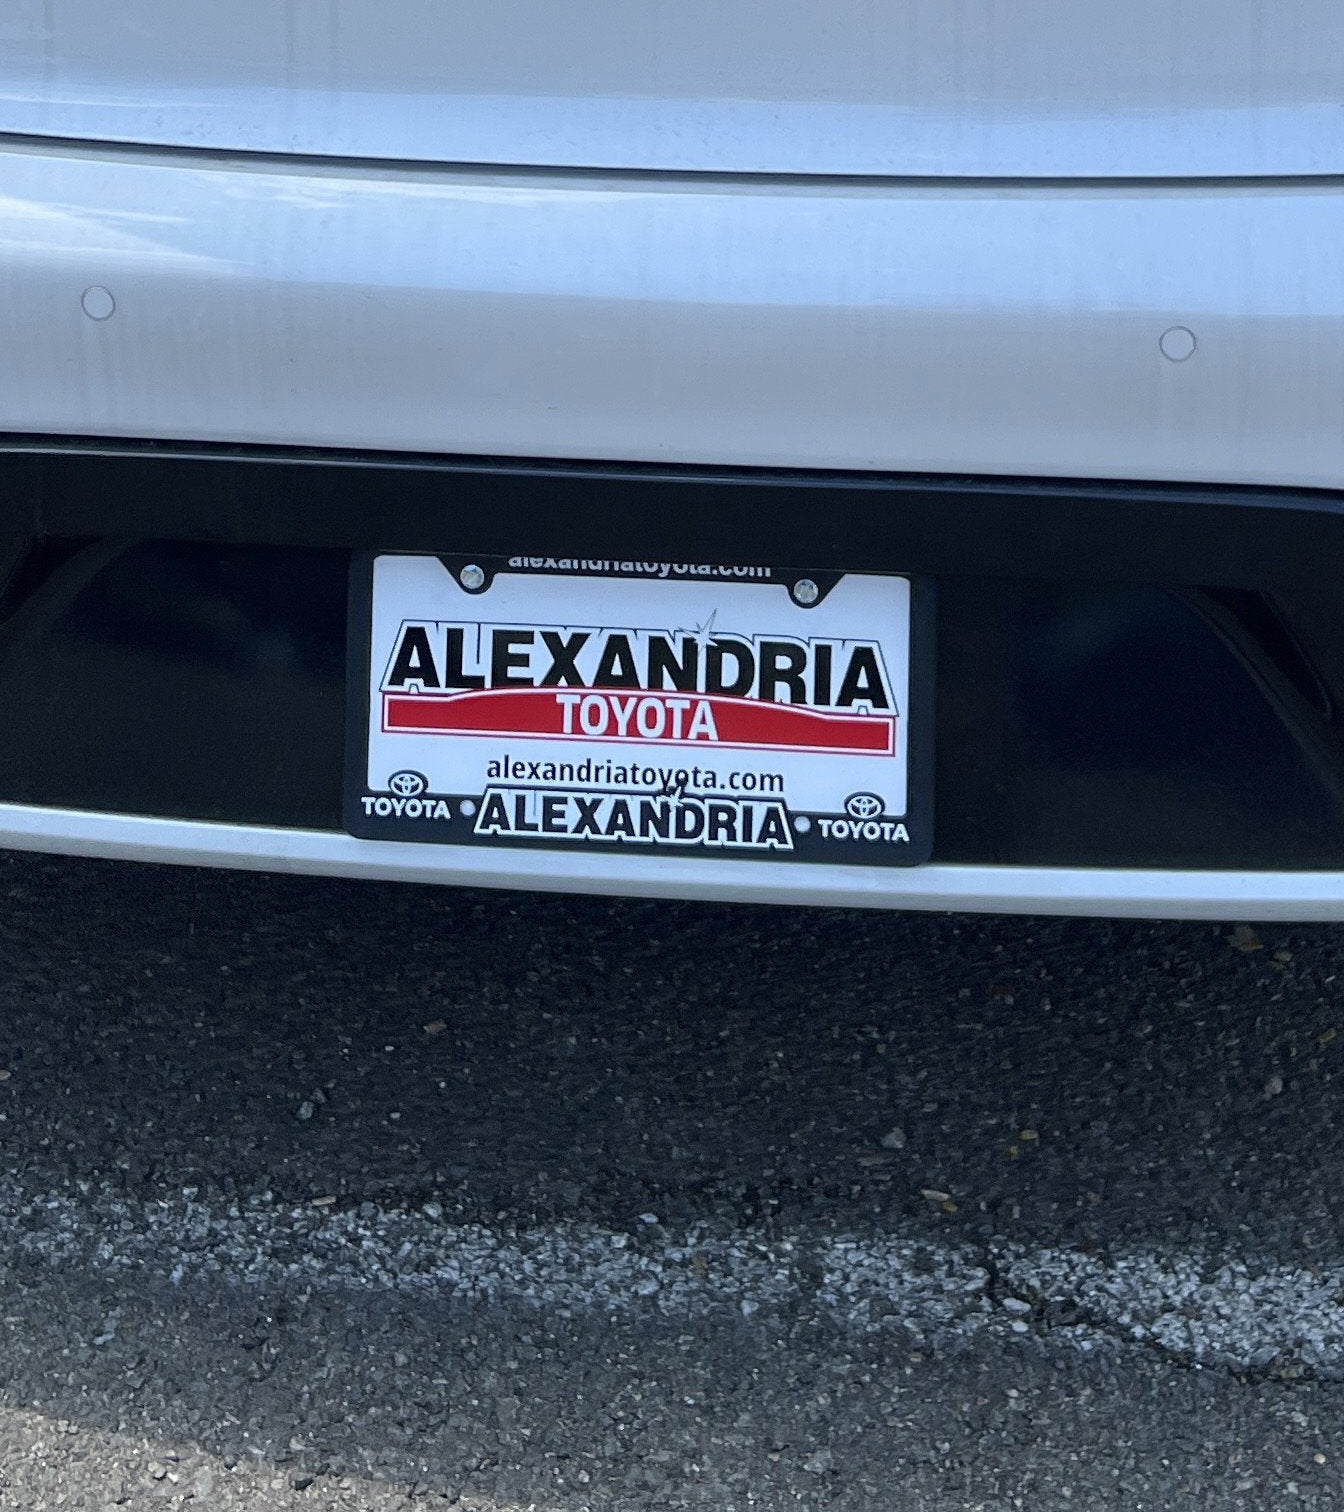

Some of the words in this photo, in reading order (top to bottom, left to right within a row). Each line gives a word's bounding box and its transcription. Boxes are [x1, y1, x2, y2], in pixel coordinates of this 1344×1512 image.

[386, 623, 890, 710] ALEXANDRIA
[556, 693, 719, 742] TOYOTA
[486, 754, 785, 792] alexandriatoyota.com
[360, 796, 452, 820] TOYOTA
[477, 790, 792, 849] ALEXANDRIA
[817, 818, 910, 843] TOYOTA
